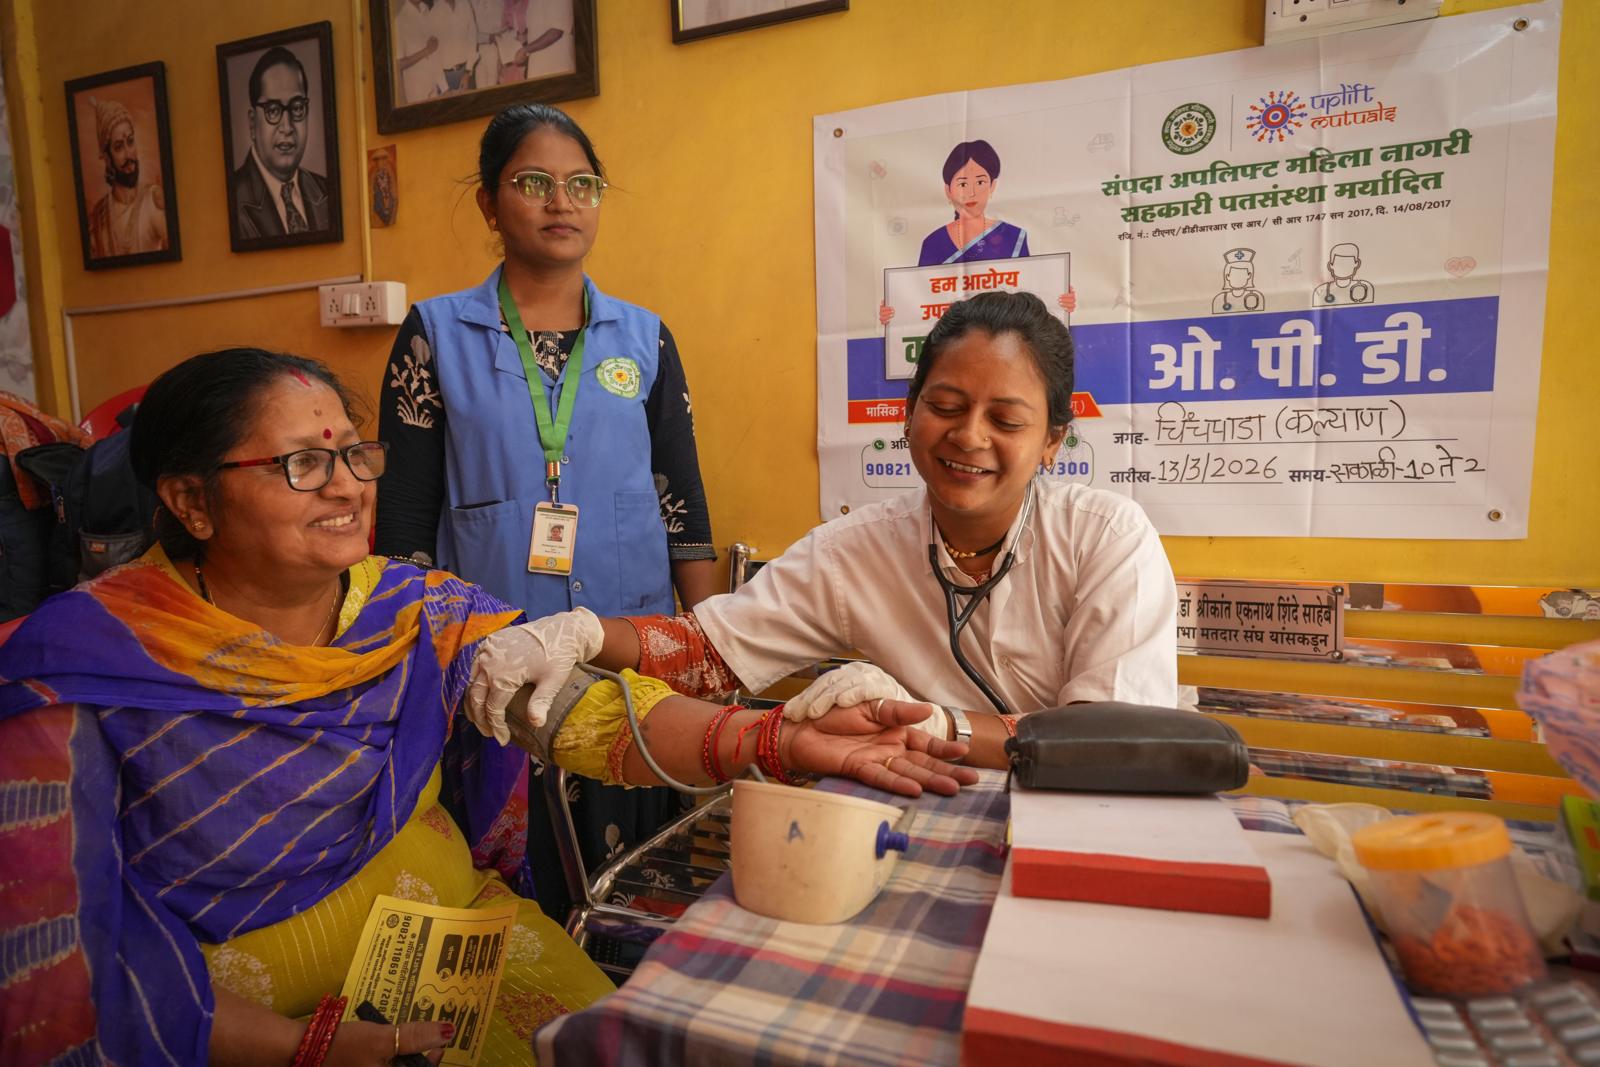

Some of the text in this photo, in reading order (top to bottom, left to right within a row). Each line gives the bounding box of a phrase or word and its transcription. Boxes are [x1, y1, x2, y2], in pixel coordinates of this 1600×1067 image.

[1310, 83, 1375, 114] uplift
[1310, 101, 1397, 129] mutuals
[1101, 127, 1473, 197] संपदा अपलिफ्ट महिला नागरी
[1120, 167, 1445, 223] सहकारी पतसंस्था मर्यादित
[1272, 215, 1282, 226] सी
[1286, 216, 1301, 225] आर
[1305, 213, 1325, 222] 1747
[1330, 211, 1343, 220] सन
[1347, 209, 1373, 218] 2017,
[1375, 205, 1389, 216] दि.
[1393, 200, 1451, 213] 14/08/2017
[929, 268, 1020, 294] हम आरोग्य
[1148, 311, 1448, 391] ओ. पी. डी.
[866, 403, 899, 417] मासिक
[1112, 432, 1149, 445] जगह-
[866, 463, 911, 476] 90821
[1158, 452, 1279, 483] 13/3/2026
[1435, 444, 1464, 477] ते
[1464, 458, 1486, 472] 2
[1109, 467, 1156, 483] तारीख-
[1196, 593, 1232, 619] श्रीकांत
[1236, 600, 1274, 626] एकनाथ
[1277, 594, 1299, 625] शिंदे
[1302, 595, 1333, 626] साहेब
[1177, 626, 1197, 639] भा
[1200, 627, 1240, 642] मतदार
[1243, 624, 1265, 643] संघ
[396, 915, 412, 944] 90821
[388, 947, 403, 975] 11869
[378, 988, 392, 1013] 7208
